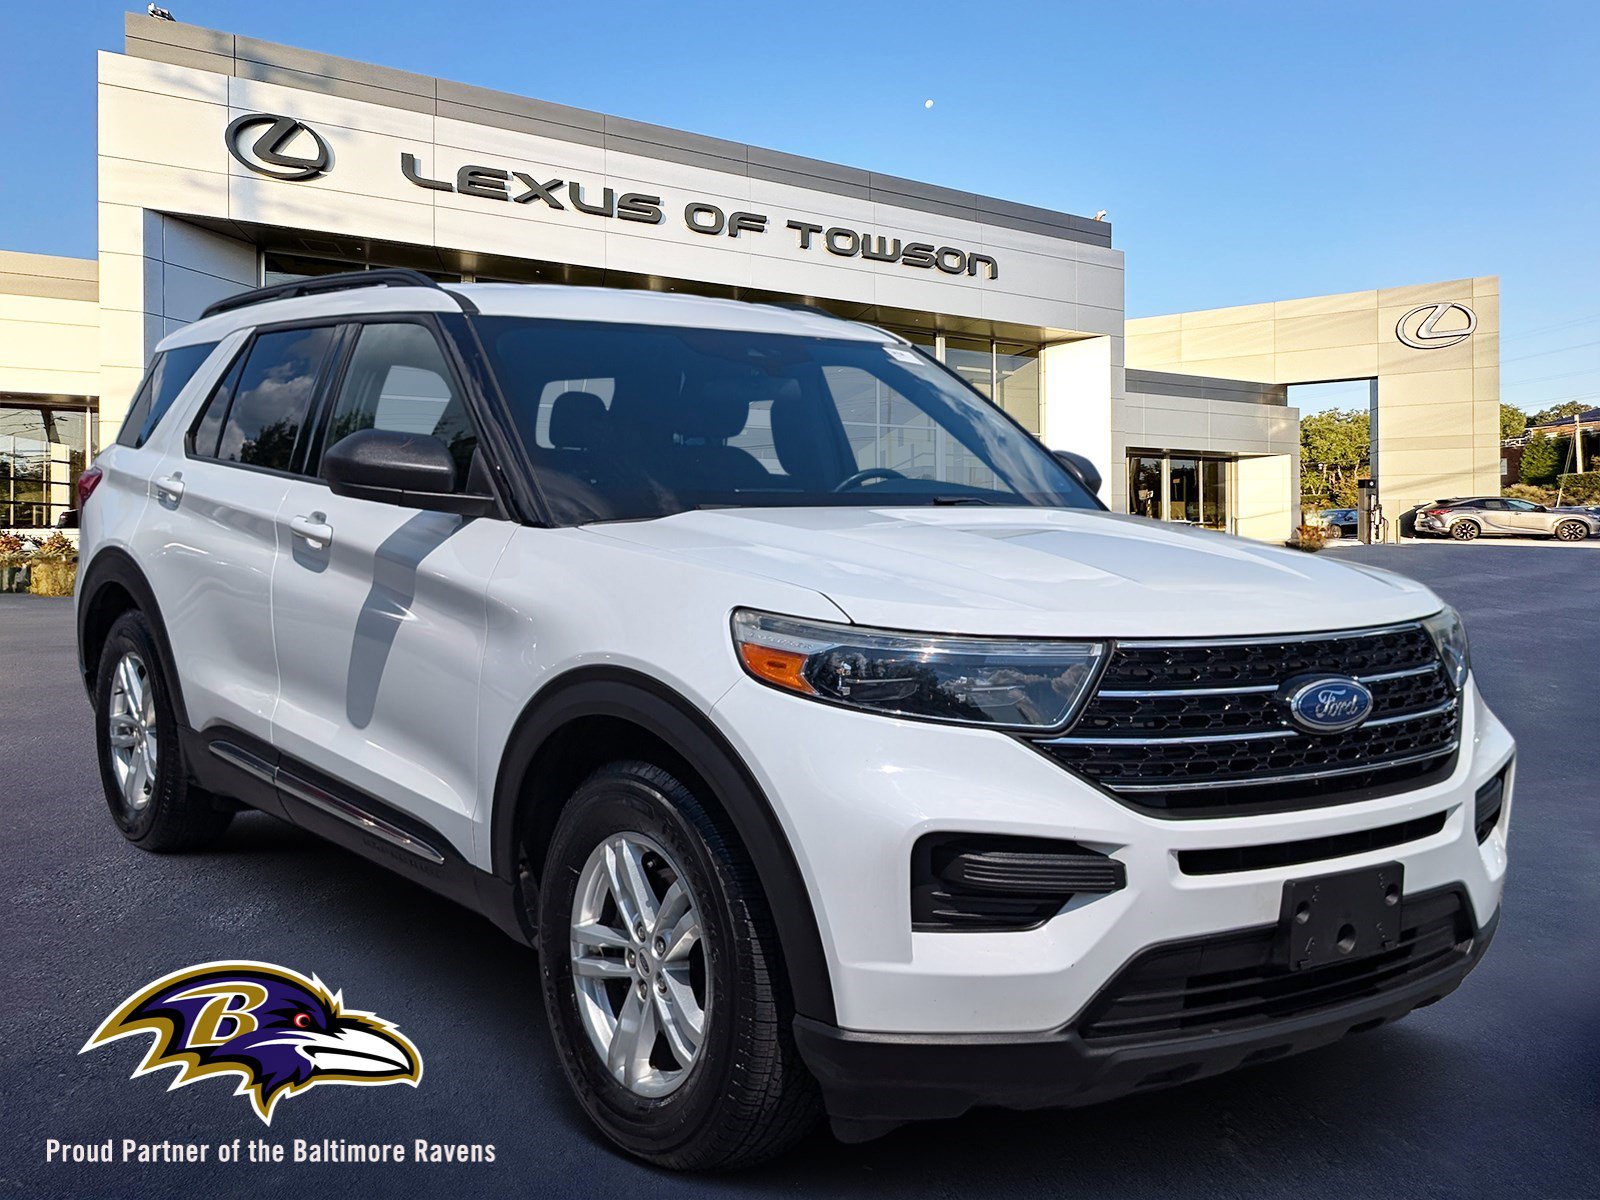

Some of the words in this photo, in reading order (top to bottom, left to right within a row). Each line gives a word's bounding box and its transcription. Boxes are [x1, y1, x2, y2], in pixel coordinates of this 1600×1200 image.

[400, 152, 663, 225] LEXUS
[684, 202, 767, 238] OF
[786, 219, 999, 280] TOWSON
[1314, 689, 1358, 718] Ford
